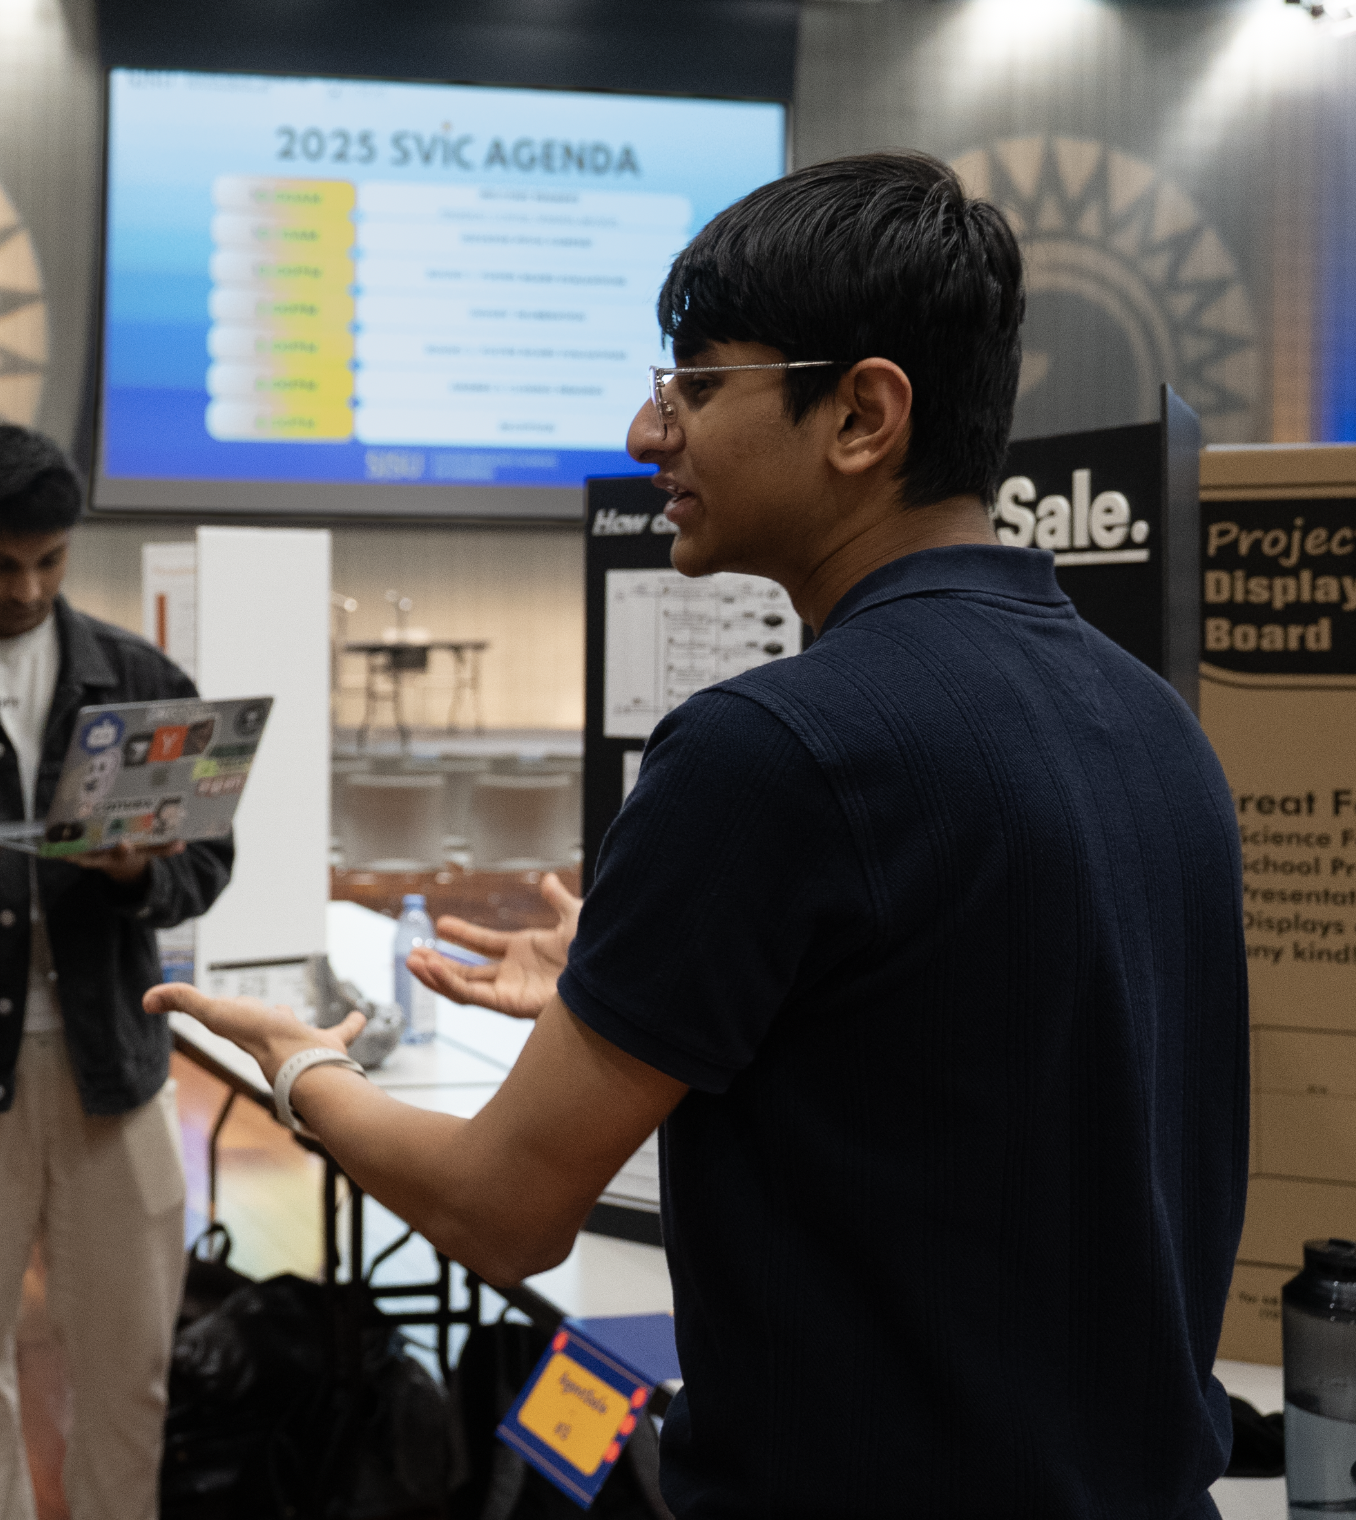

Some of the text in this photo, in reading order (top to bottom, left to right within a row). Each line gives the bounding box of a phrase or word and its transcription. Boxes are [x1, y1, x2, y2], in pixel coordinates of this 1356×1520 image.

[275, 124, 378, 165] 2025
[482, 134, 641, 177] AGENDA
[593, 508, 651, 536] How
[1206, 516, 1356, 568] Projec
[1204, 568, 1356, 612] Display
[1204, 616, 1333, 651] Board
[1234, 788, 1316, 817] reat
